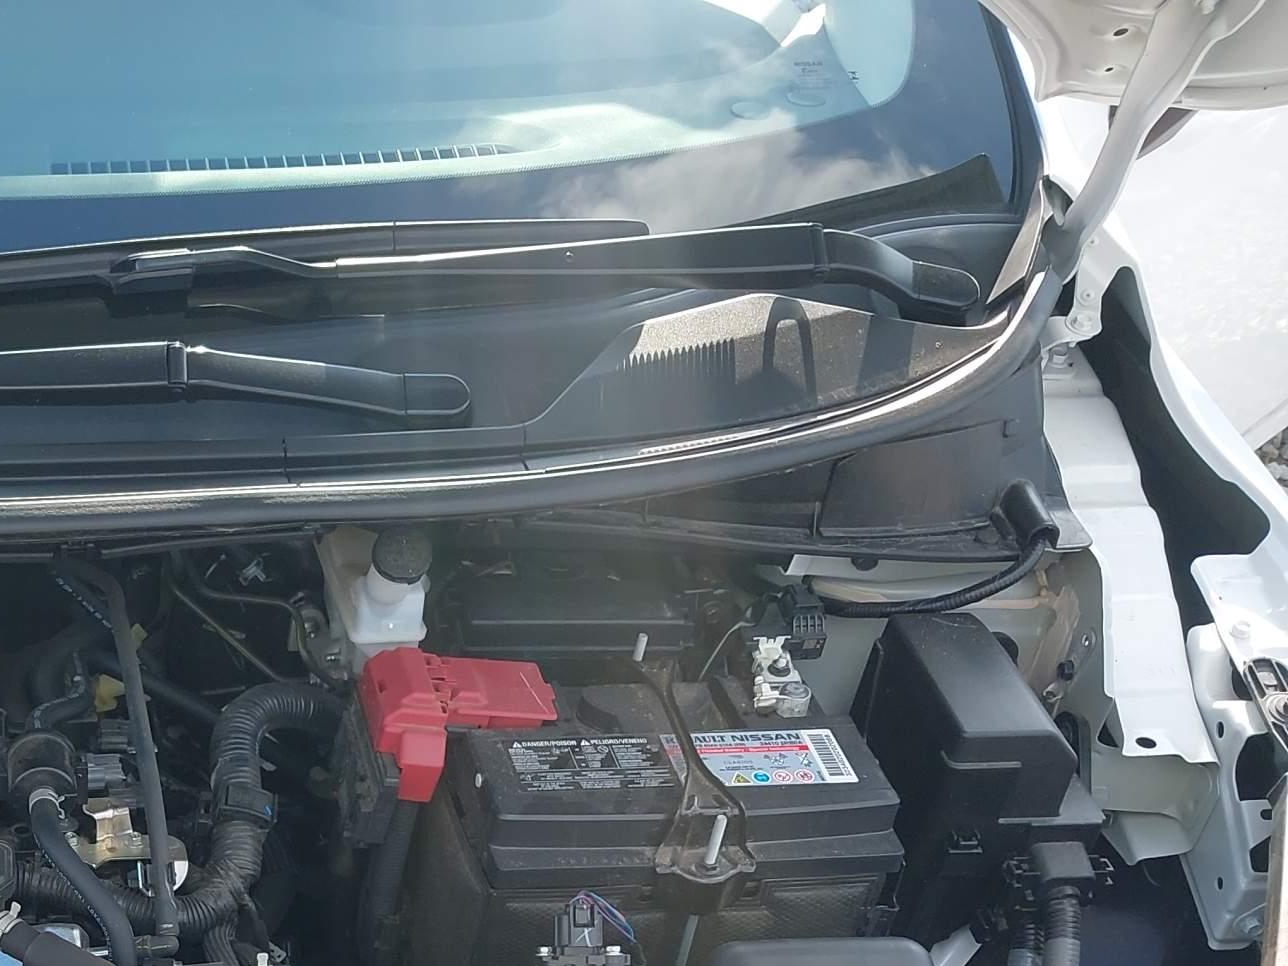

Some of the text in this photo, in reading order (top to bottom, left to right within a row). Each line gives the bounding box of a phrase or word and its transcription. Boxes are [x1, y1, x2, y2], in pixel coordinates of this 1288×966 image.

[664, 734, 725, 745] RAULT
[728, 732, 800, 743] NISSAN
[522, 740, 577, 748] DANGER/POISON
